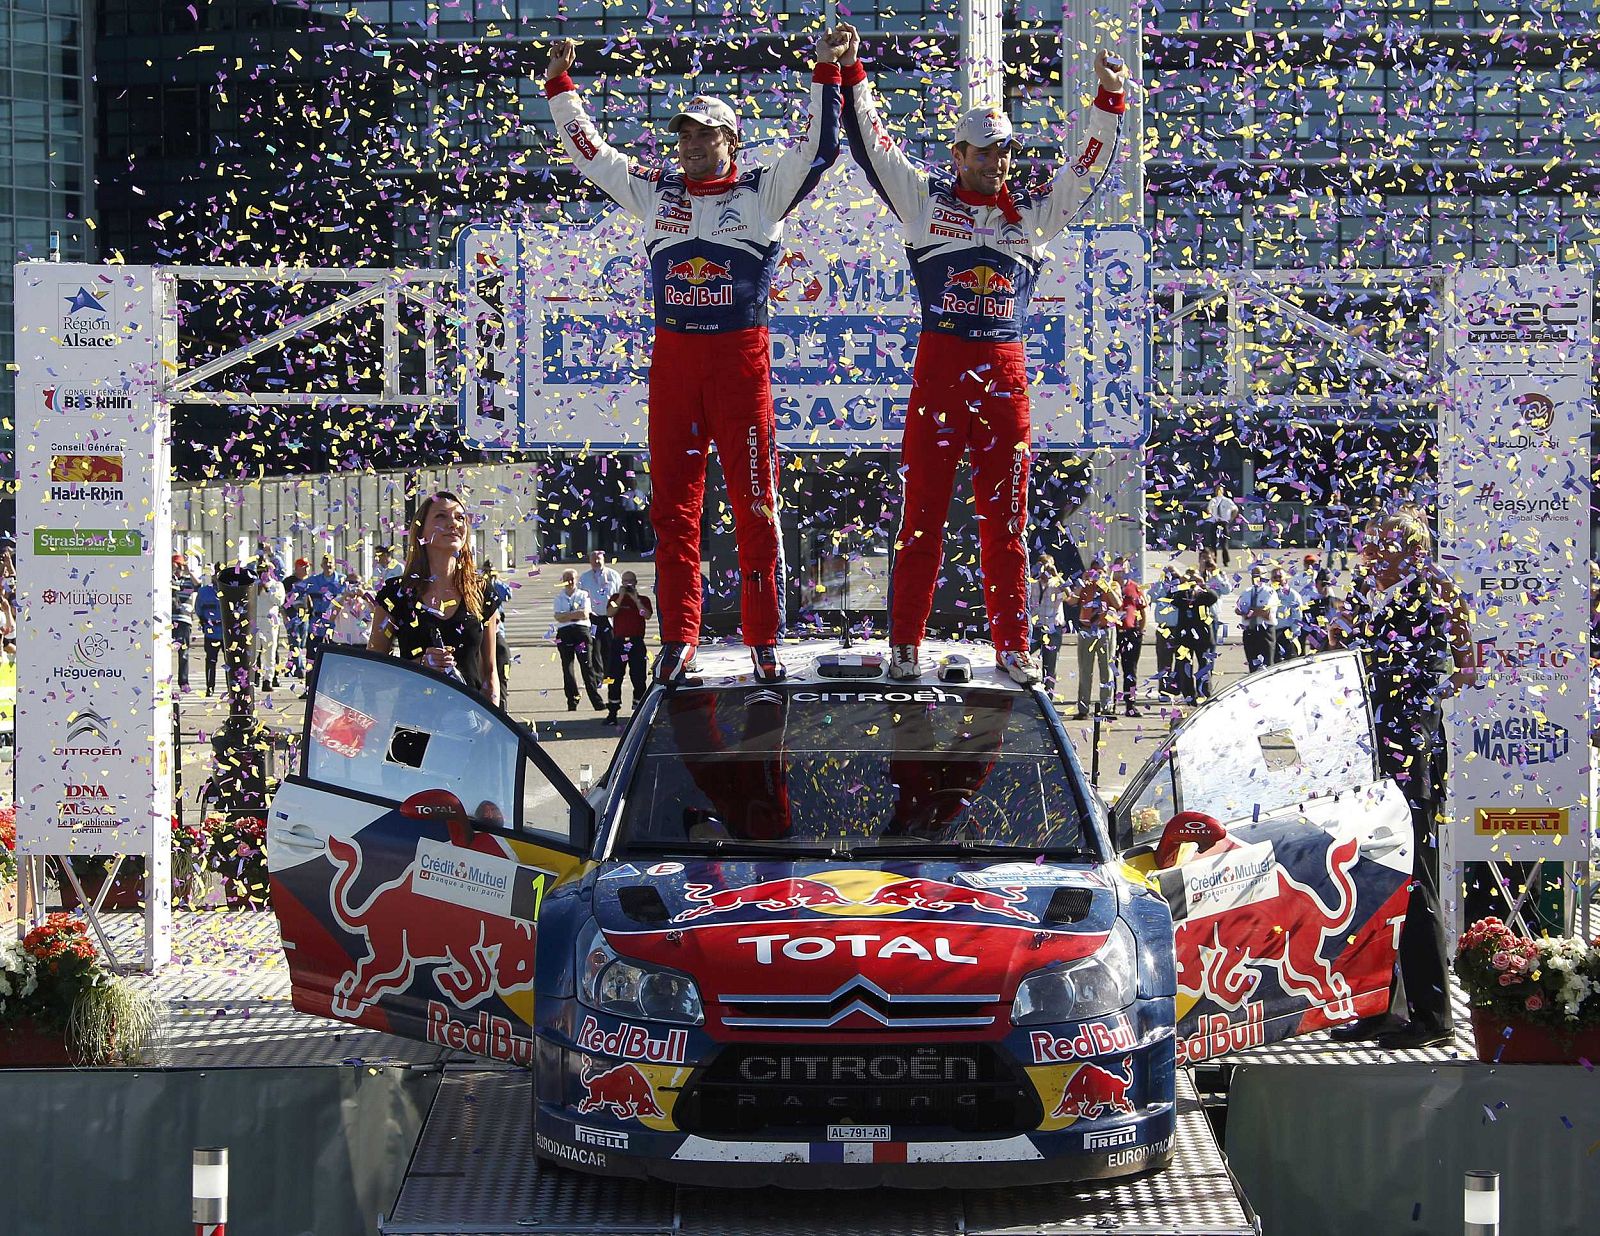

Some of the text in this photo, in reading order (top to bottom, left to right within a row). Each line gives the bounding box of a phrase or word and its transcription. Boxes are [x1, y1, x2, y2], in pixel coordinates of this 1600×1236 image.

[577, 133, 593, 157] TOTAL
[1081, 143, 1099, 165] TOTAL
[656, 220, 689, 235] PIRELLI
[945, 213, 972, 226] TOTAL
[930, 223, 973, 240] PIRELLI
[665, 284, 734, 306] Red Bull
[943, 292, 1015, 320] Red Bull
[63, 316, 110, 334] Région
[62, 333, 113, 347] Alsace
[1105, 260, 1132, 416] 2010
[769, 333, 828, 368] DE
[773, 397, 909, 431] SACE
[51, 442, 123, 452] Conseil Général
[1011, 447, 1023, 514] CITROË
[51, 486, 124, 501] Haut-Rhin
[59, 591, 133, 605] MULHOUSE
[53, 667, 122, 680] Haguenau
[1554, 672, 1569, 681] Pro
[66, 784, 109, 797] DNA
[415, 804, 456, 815] TOTAL
[58, 818, 67, 826] Le
[1179, 828, 1212, 836] OAKLEY
[1482, 812, 1561, 830] PIRELLI
[420, 853, 506, 890] Crédit Mutuel
[655, 864, 674, 874] E
[1190, 859, 1270, 891] Crédit Mutuel
[420, 870, 430, 879] LA
[430, 874, 458, 888] banque
[467, 885, 480, 895] qui
[480, 888, 505, 899] parler
[532, 874, 544, 922] 1
[737, 933, 977, 965] TOTAL
[427, 1000, 534, 1063] Red Bu
[576, 1014, 688, 1064] Red Bull
[1029, 1013, 1138, 1064] Red Bull
[1209, 998, 1266, 1058] Bull
[574, 1124, 630, 1150] PIRELLI
[831, 1126, 887, 1139] AL-791-AR
[1083, 1124, 1137, 1150] PIRELLI
[535, 1132, 607, 1169] EURODATACAR
